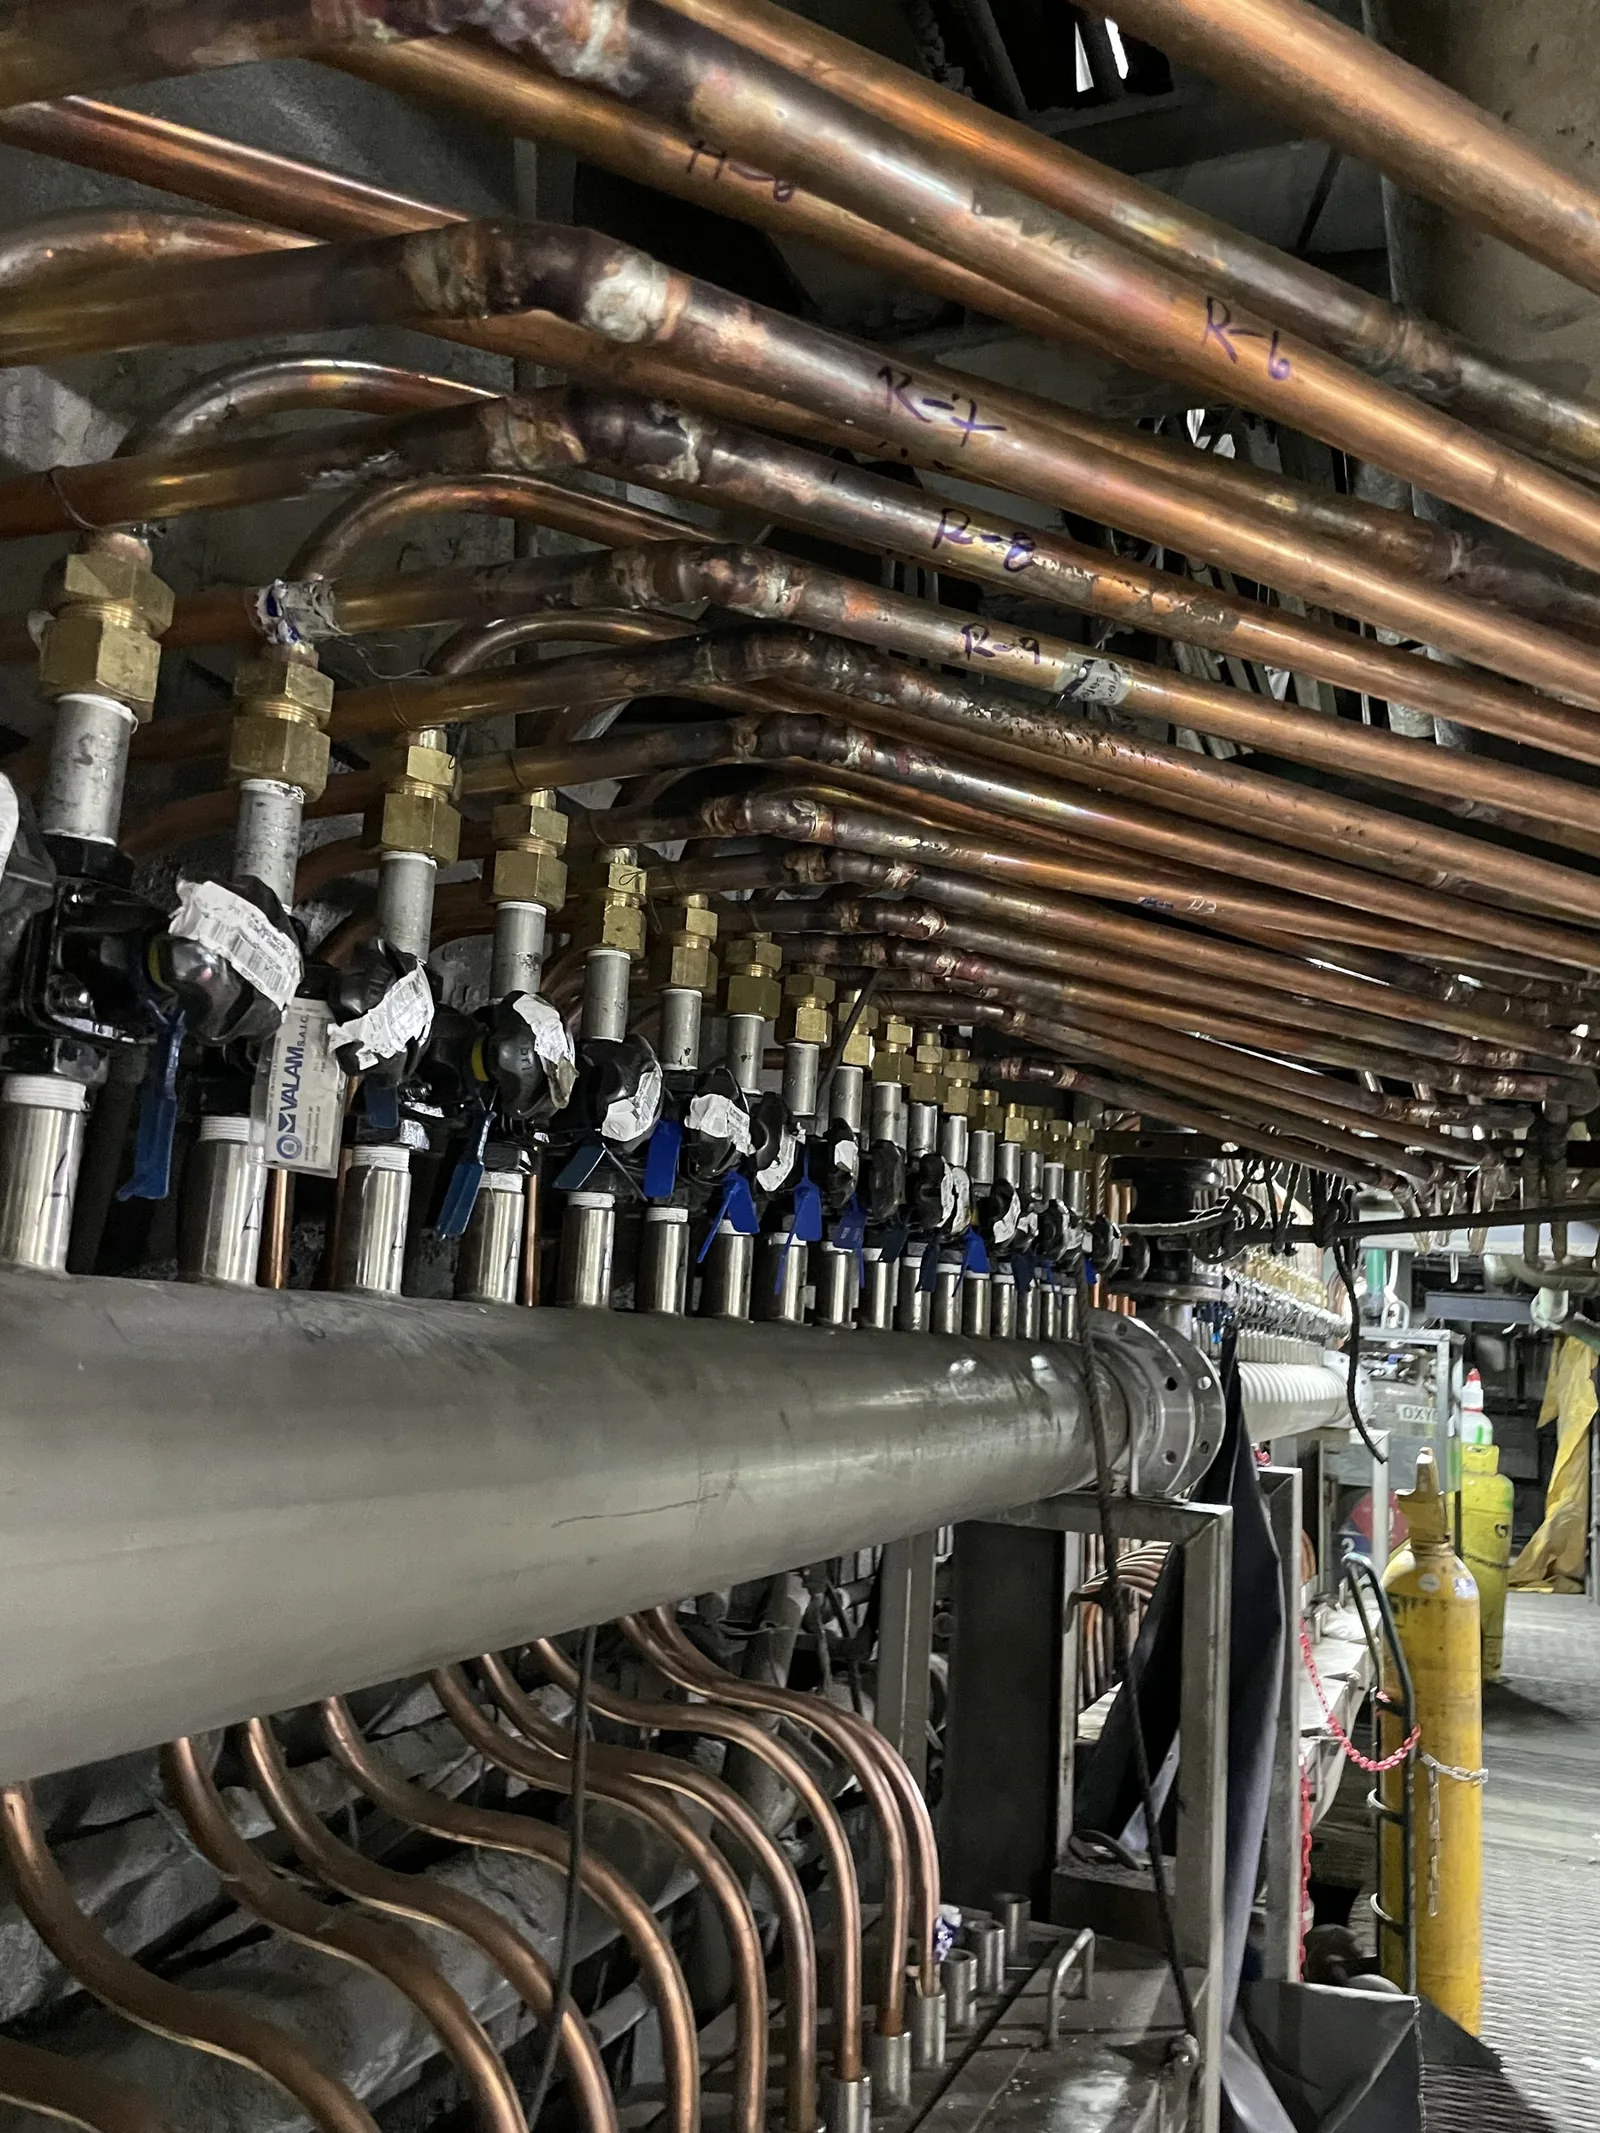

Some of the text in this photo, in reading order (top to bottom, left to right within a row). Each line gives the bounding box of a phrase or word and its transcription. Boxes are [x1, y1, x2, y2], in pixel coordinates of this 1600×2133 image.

[1200, 296, 1291, 380] R-6
[931, 507, 1036, 573] R-8
[961, 623, 1041, 665] R-9
[280, 1046, 305, 1112] VALAM
